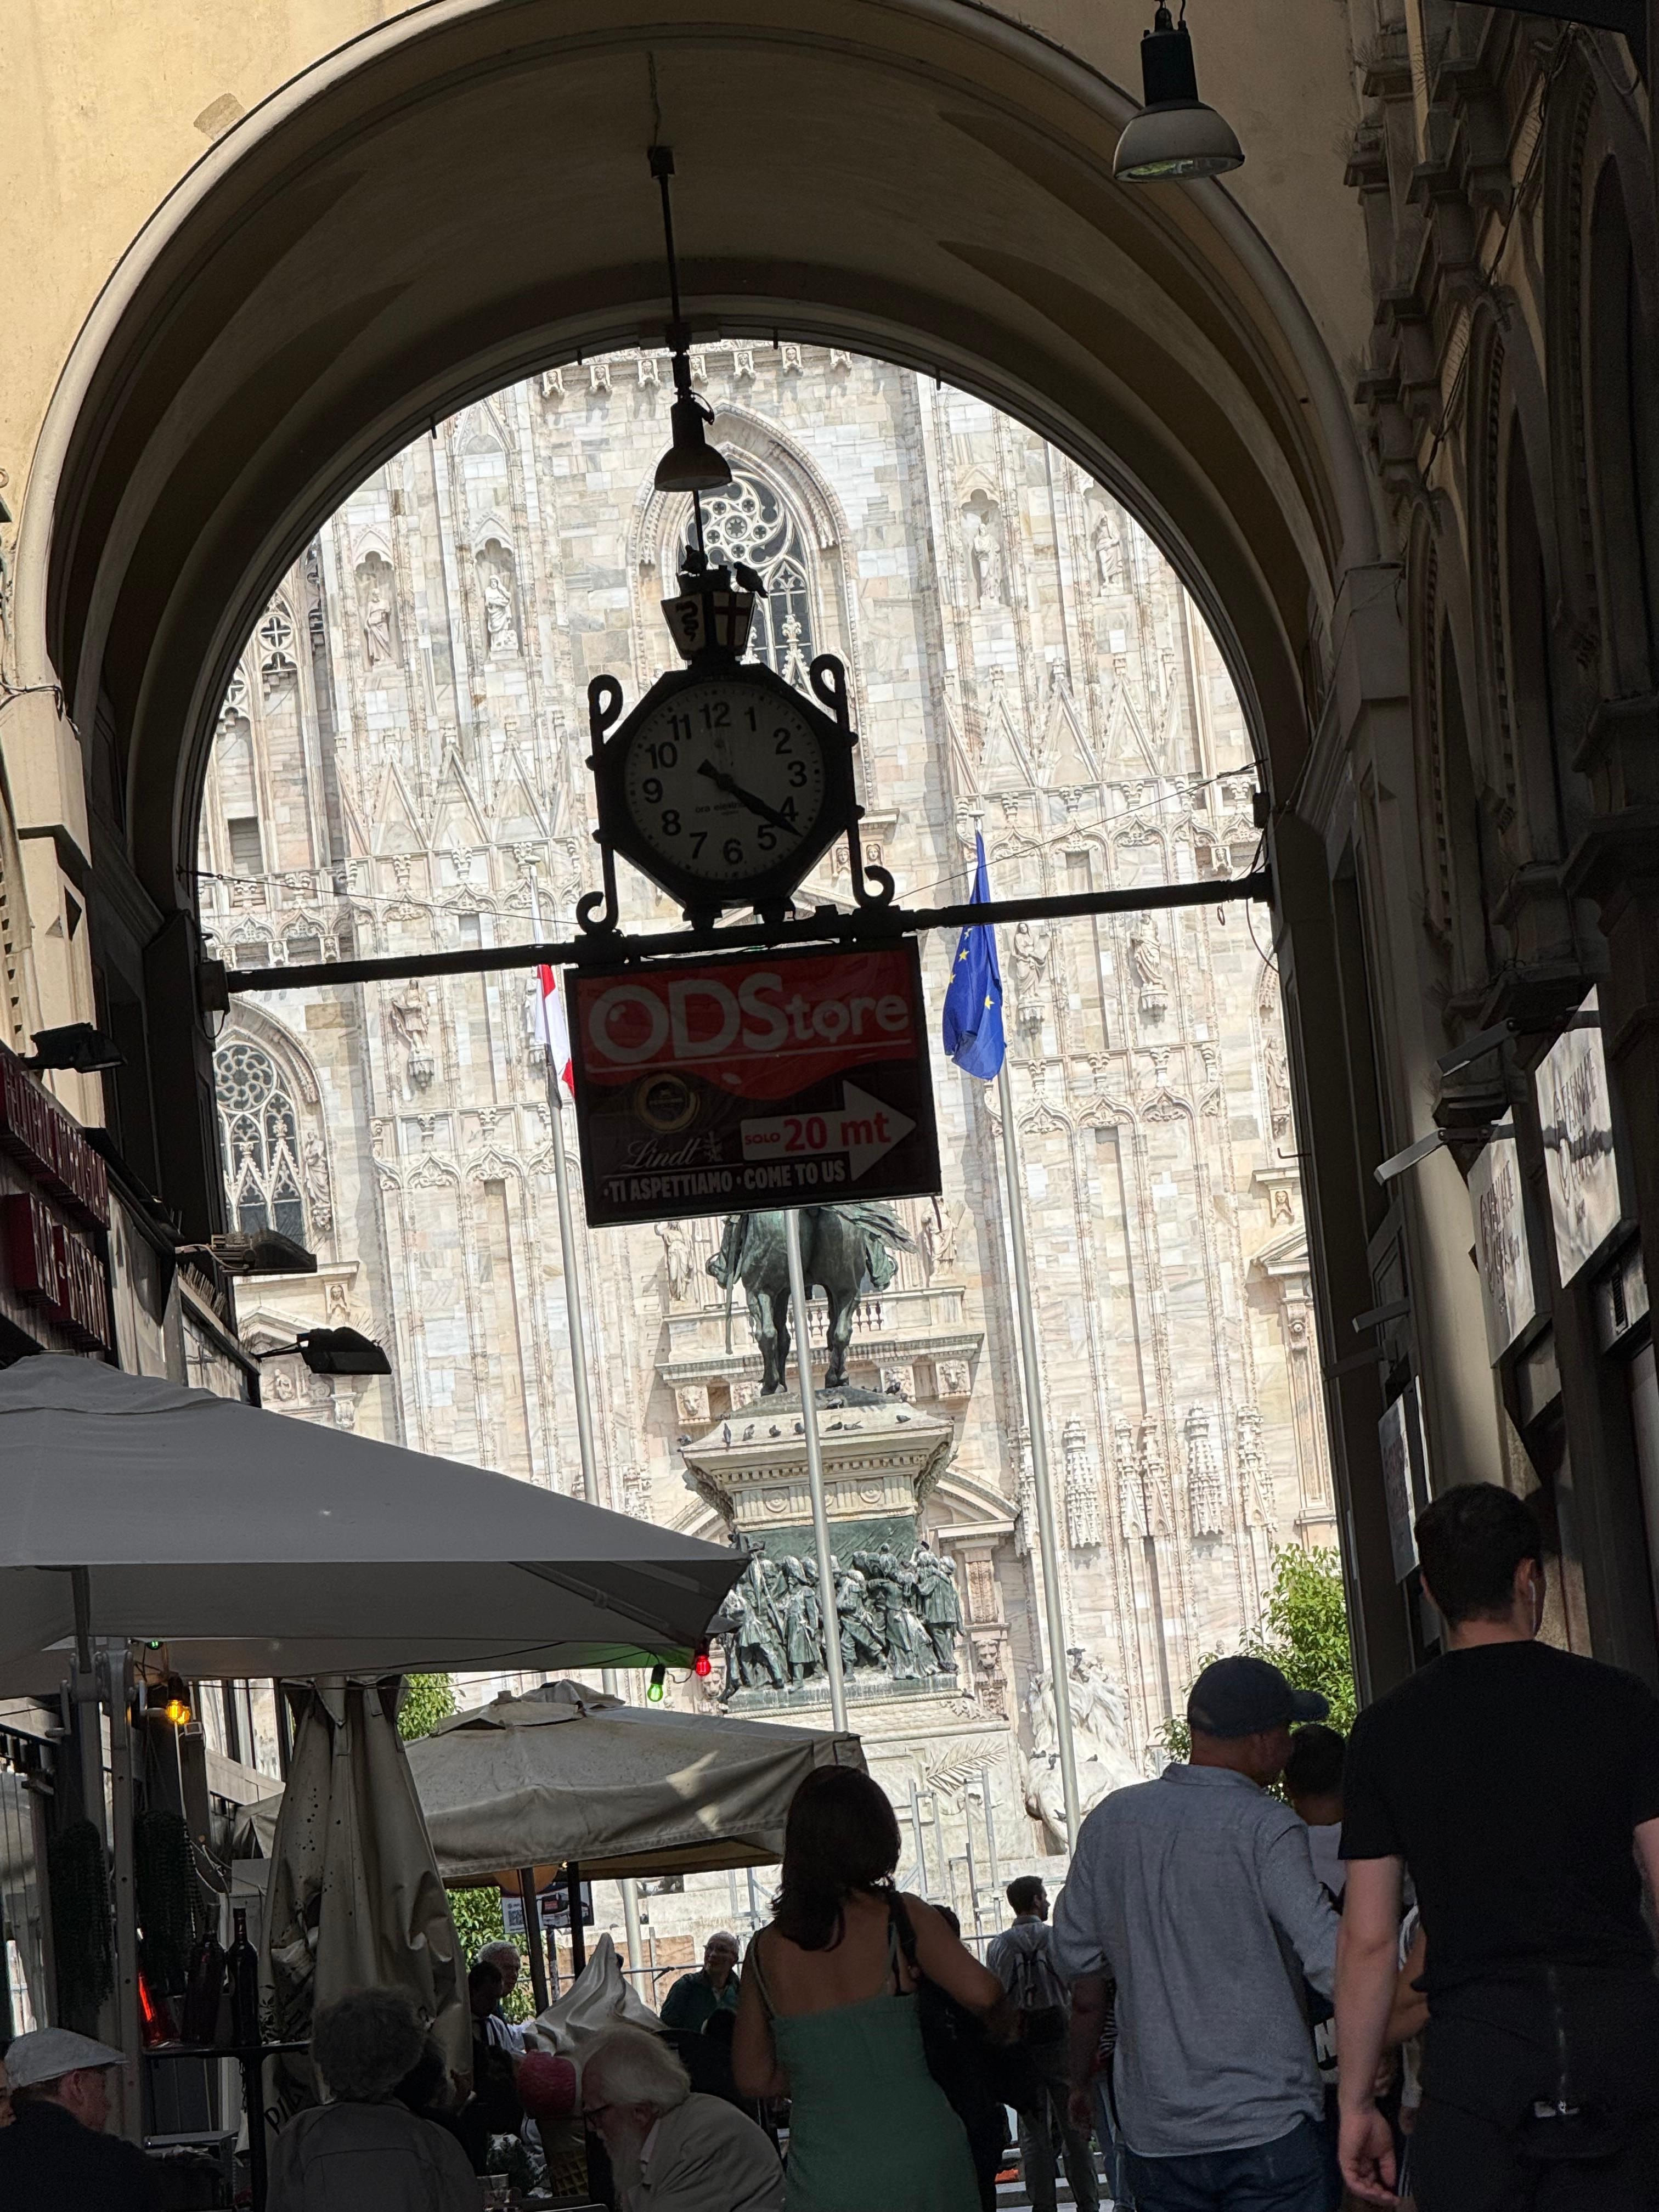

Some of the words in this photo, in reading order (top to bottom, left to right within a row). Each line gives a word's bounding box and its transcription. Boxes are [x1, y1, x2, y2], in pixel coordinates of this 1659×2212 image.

[667, 714, 691, 741] 11
[699, 702, 731, 729] 12
[744, 706, 757, 731] 1
[774, 728, 792, 754] 2
[645, 742, 678, 769] 10
[787, 761, 807, 787] 3
[642, 778, 663, 804] 9
[779, 797, 798, 821] 4
[662, 810, 681, 836] 8
[690, 831, 707, 859] 7
[758, 824, 777, 850] 5
[724, 838, 743, 865] 6
[588, 972, 910, 1064] ODStore
[744, 1132, 780, 1146] SOLO
[784, 1117, 827, 1151] 20
[841, 1112, 891, 1146] mt
[620, 1137, 702, 1170] Lindt
[630, 1170, 733, 1201] ASPETTIAMO
[744, 1164, 792, 1190] COME
[795, 1161, 819, 1186] TO
[821, 1159, 846, 1183] US
